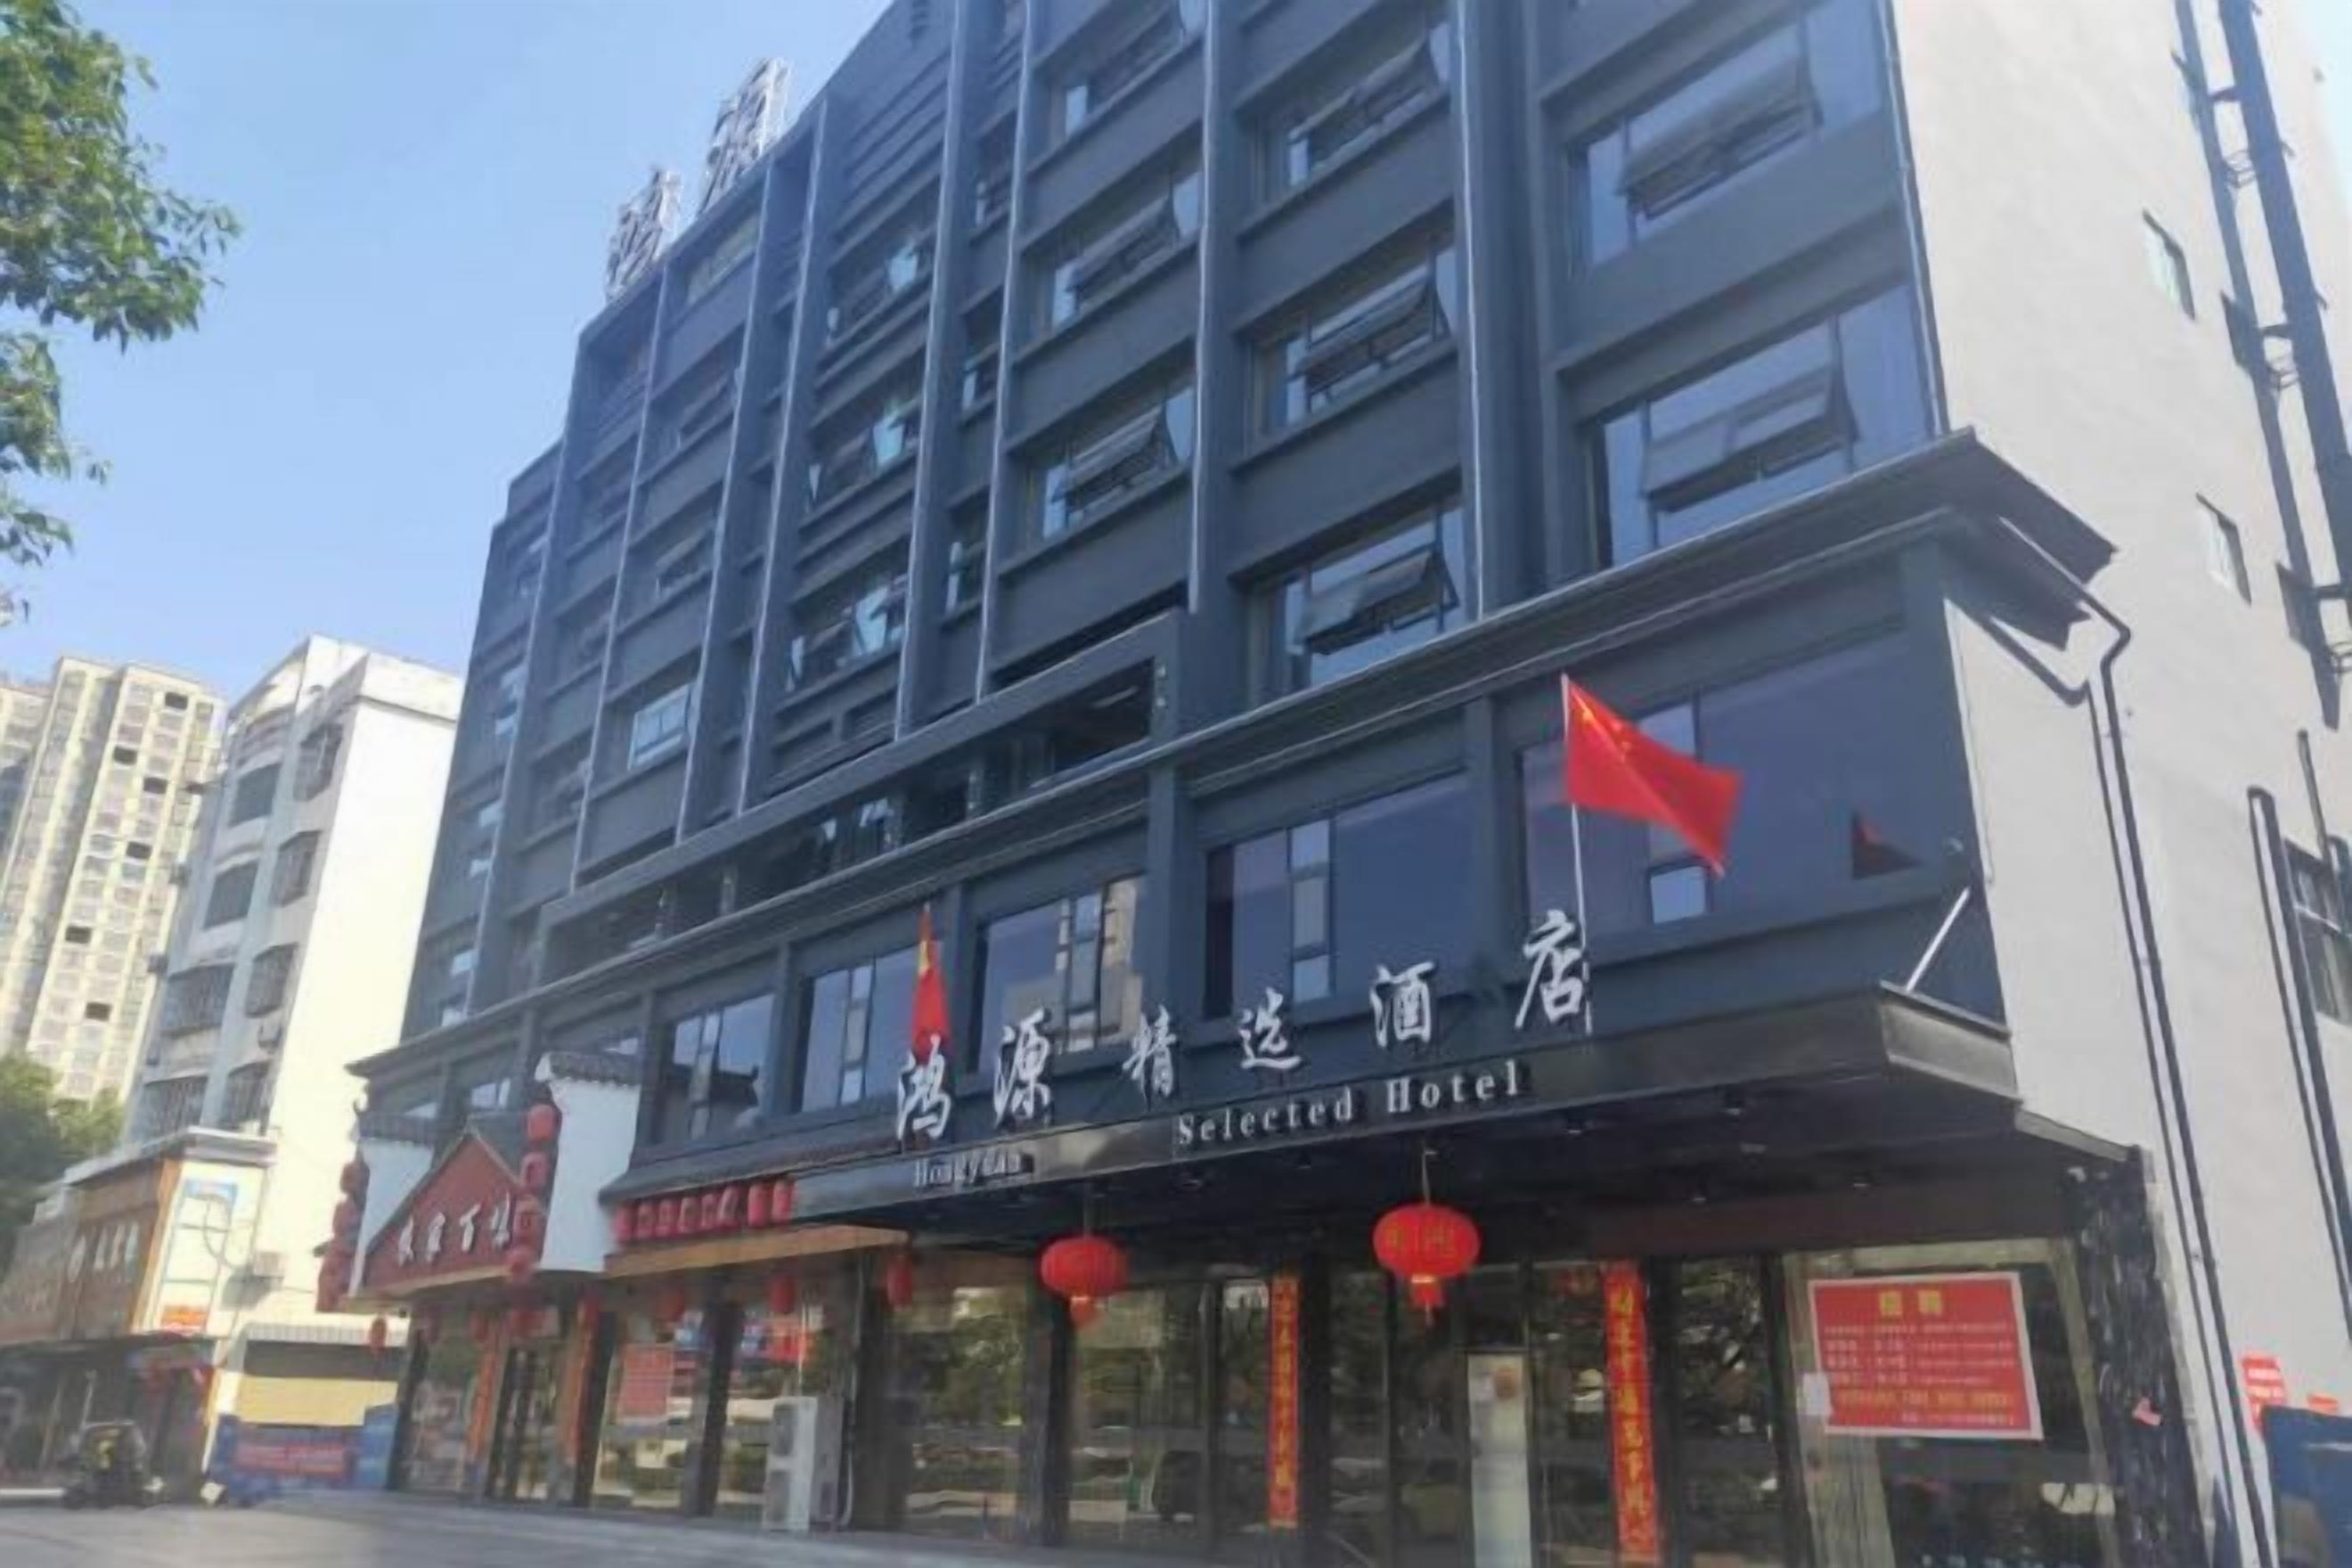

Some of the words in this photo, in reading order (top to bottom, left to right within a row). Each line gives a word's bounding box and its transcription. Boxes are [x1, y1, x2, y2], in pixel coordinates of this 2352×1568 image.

[895, 909, 1584, 1142] 鸿源精选酒店
[1178, 1087, 1352, 1145] Selected
[1386, 1059, 1518, 1114] Hotel
